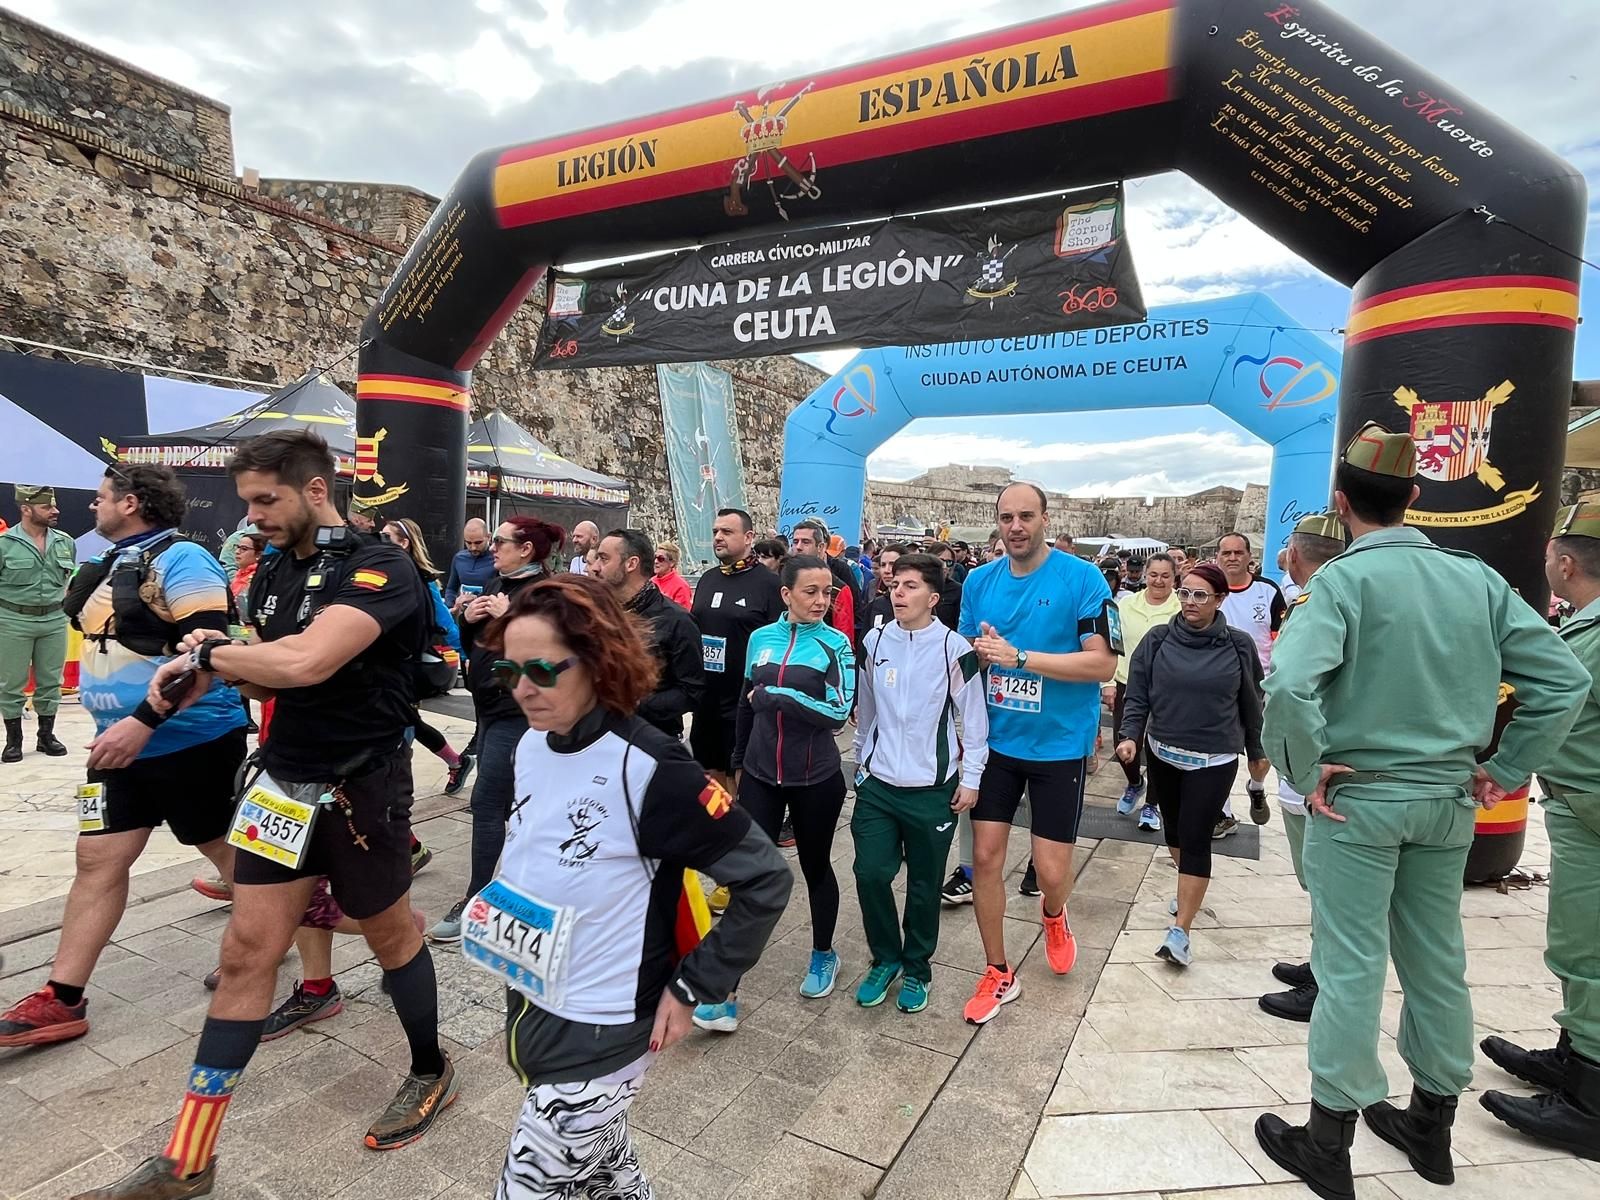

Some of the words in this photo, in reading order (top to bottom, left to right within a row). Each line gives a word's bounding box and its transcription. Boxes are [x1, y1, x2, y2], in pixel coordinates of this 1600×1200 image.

[858, 44, 1079, 123] ESPAÑOLA
[1264, 3, 1352, 66] Espíritu
[1352, 65, 1383, 82] de
[1376, 79, 1403, 97] la
[1402, 90, 1494, 158] Muerte
[1236, 29, 1264, 49] El
[1254, 46, 1287, 69] morir
[1285, 66, 1301, 80] en
[1299, 77, 1320, 87] el
[1311, 85, 1358, 117] combate
[1356, 114, 1373, 127] es
[1370, 124, 1393, 134] el
[1382, 132, 1423, 156] mayor
[1420, 155, 1460, 186] honor.
[1249, 63, 1281, 87] No
[1270, 83, 1284, 95] se
[1281, 91, 1318, 118] muere
[1316, 115, 1342, 133] más
[1335, 131, 1363, 149] que
[1362, 145, 1389, 166] una
[1387, 162, 1412, 182] vez.
[1221, 69, 1243, 94] La
[1241, 89, 1280, 119] muerte
[1277, 112, 1308, 137] llega
[1305, 136, 1326, 152] sin
[1325, 146, 1356, 171] dolor
[1345, 169, 1367, 183] y
[1364, 176, 1388, 188] el
[1377, 183, 1413, 210] morir
[557, 137, 658, 188] LEGIÓN
[1210, 111, 1229, 134] Lo
[1228, 132, 1251, 149] más
[1249, 144, 1295, 180] horrible
[1291, 177, 1306, 189] es
[1305, 185, 1333, 207] vivir
[1332, 205, 1372, 234] siendo
[1220, 103, 1237, 116] no
[1236, 113, 1250, 124] es
[1248, 119, 1270, 138] tan
[1267, 132, 1315, 168] horrible
[1311, 166, 1339, 188] como
[1331, 184, 1379, 216] parece.
[1250, 169, 1267, 184] un
[1067, 235, 1098, 247] Shop
[1070, 216, 1092, 228] The
[710, 250, 765, 268] CARRERA
[768, 233, 871, 261] CÍVICO-MILITAR
[736, 277, 771, 304] DE
[777, 271, 812, 297] LA
[733, 305, 837, 343] CEUTA
[905, 339, 995, 359] INSTITUTO
[1062, 331, 1089, 348] DE
[1094, 318, 1209, 345] DEPORTES
[921, 371, 981, 387] CIUDAD
[986, 363, 1087, 384] AUTÓNOMA
[1092, 361, 1117, 376] DE
[1123, 355, 1187, 374] CEUTA
[780, 498, 819, 517] Ceuta
[823, 505, 840, 514] es
[1405, 513, 1421, 521] UAN
[1004, 677, 1038, 697] 1245
[260, 812, 304, 843] 4557
[493, 911, 543, 963] 1474
